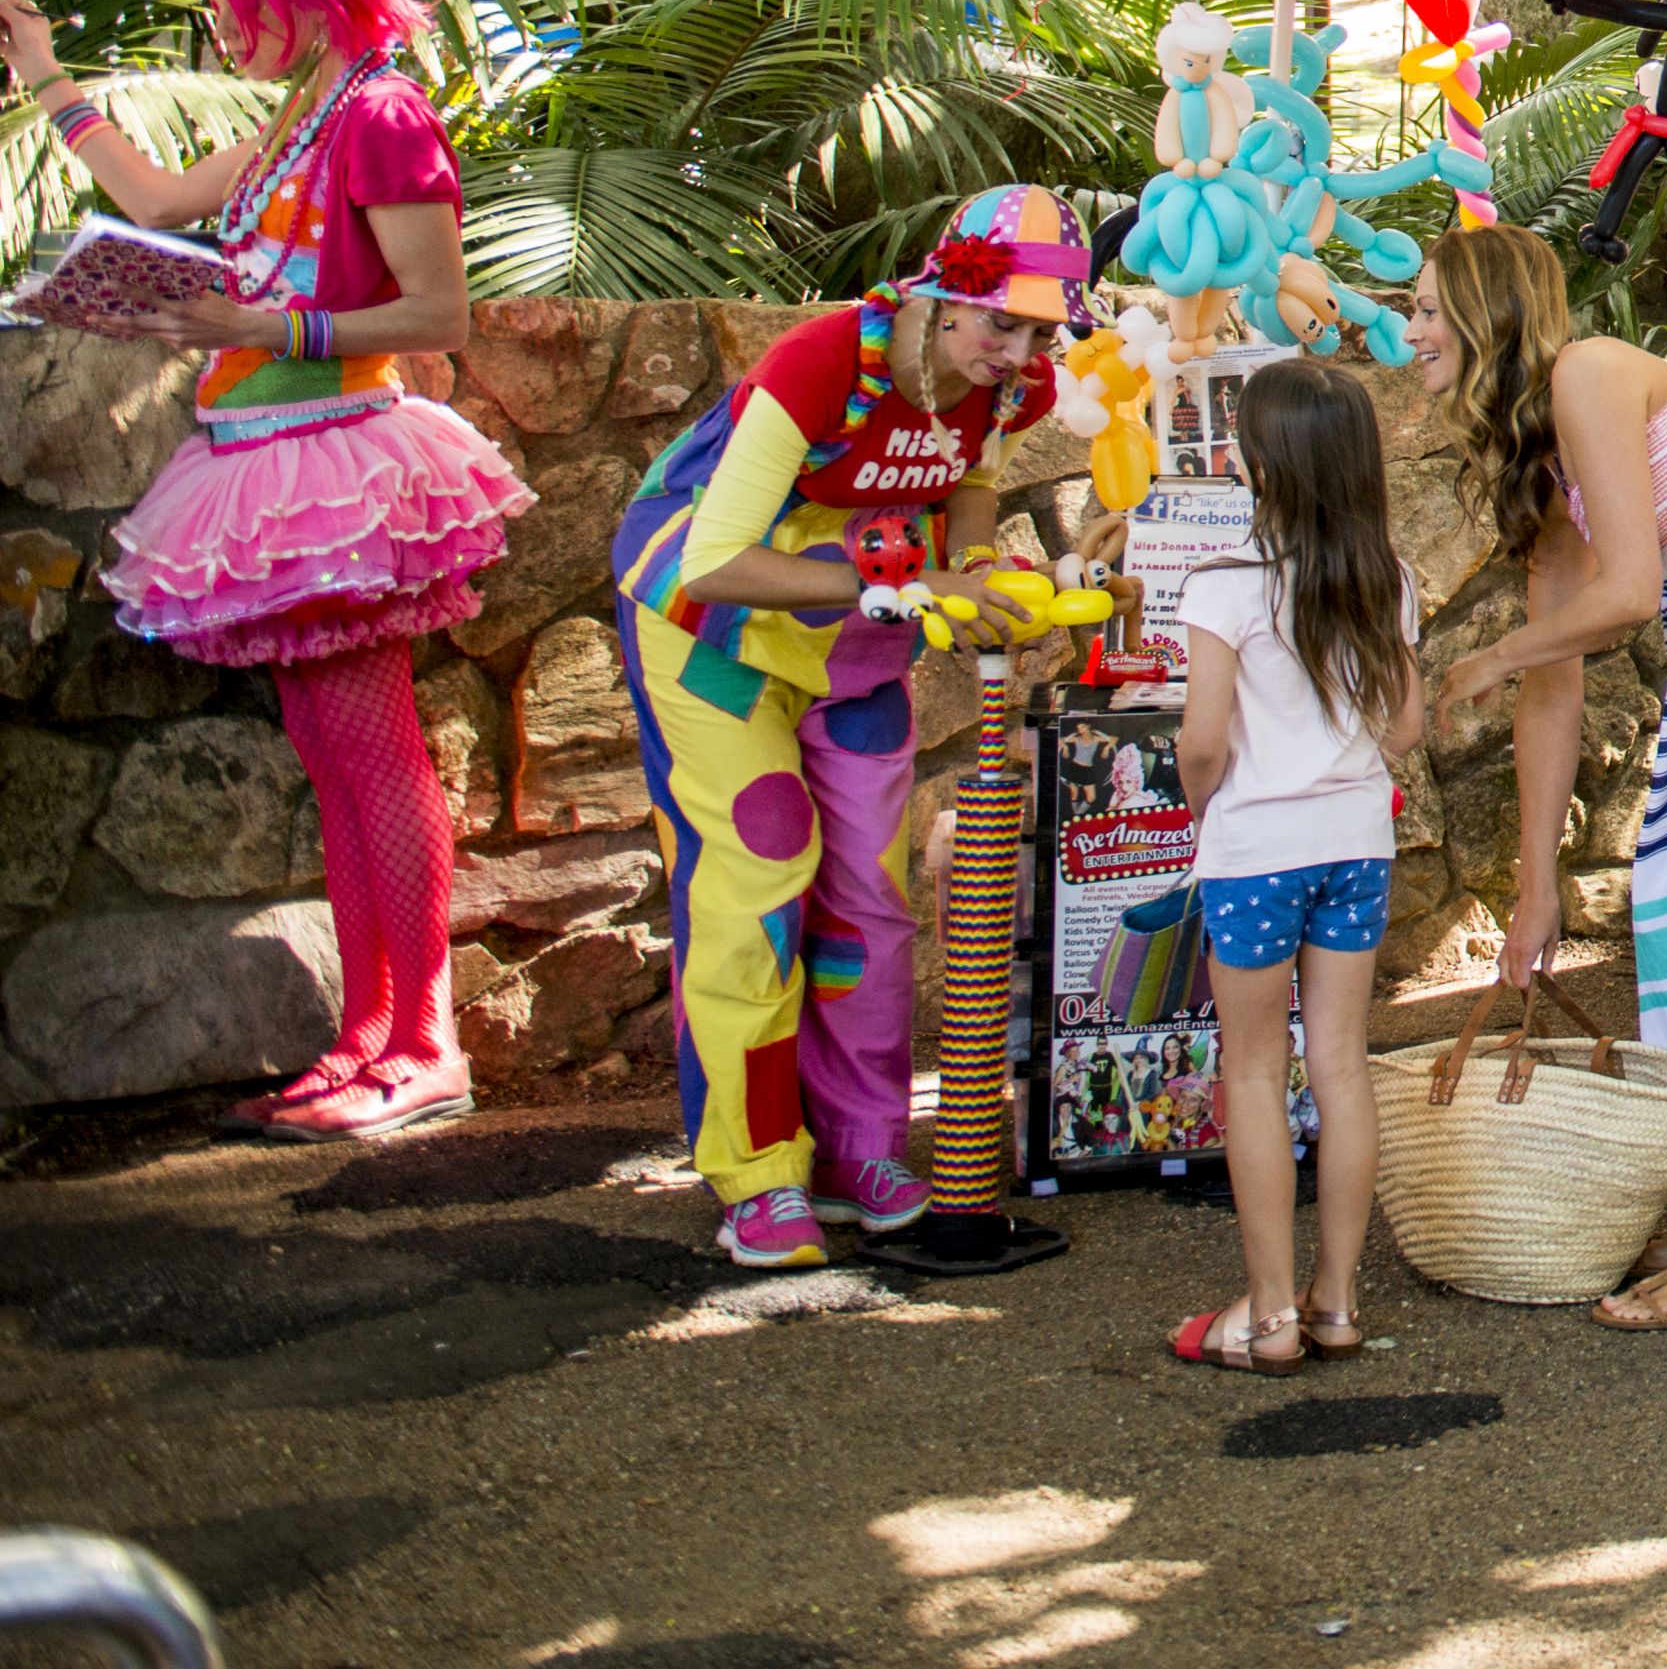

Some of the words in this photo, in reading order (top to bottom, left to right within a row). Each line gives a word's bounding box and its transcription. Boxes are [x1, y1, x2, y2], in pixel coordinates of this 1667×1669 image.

[852, 457, 967, 490] Donna
[1225, 500, 1238, 509] us
[1171, 510, 1253, 526] facebook
[1133, 542, 1157, 551] Miss
[1160, 542, 1196, 551] Donna
[1199, 542, 1218, 552] The
[1131, 562, 1143, 571] Be
[1145, 562, 1182, 571] Amazed
[1143, 604, 1157, 612] ke
[1083, 845, 1194, 869] ENTERTAINMENT
[1097, 885, 1128, 893] events
[1064, 905, 1099, 914] Balloon
[1064, 916, 1102, 925] Comedy
[1064, 927, 1083, 936] Kids
[1064, 938, 1095, 947] Roving
[1064, 949, 1091, 957] Circus
